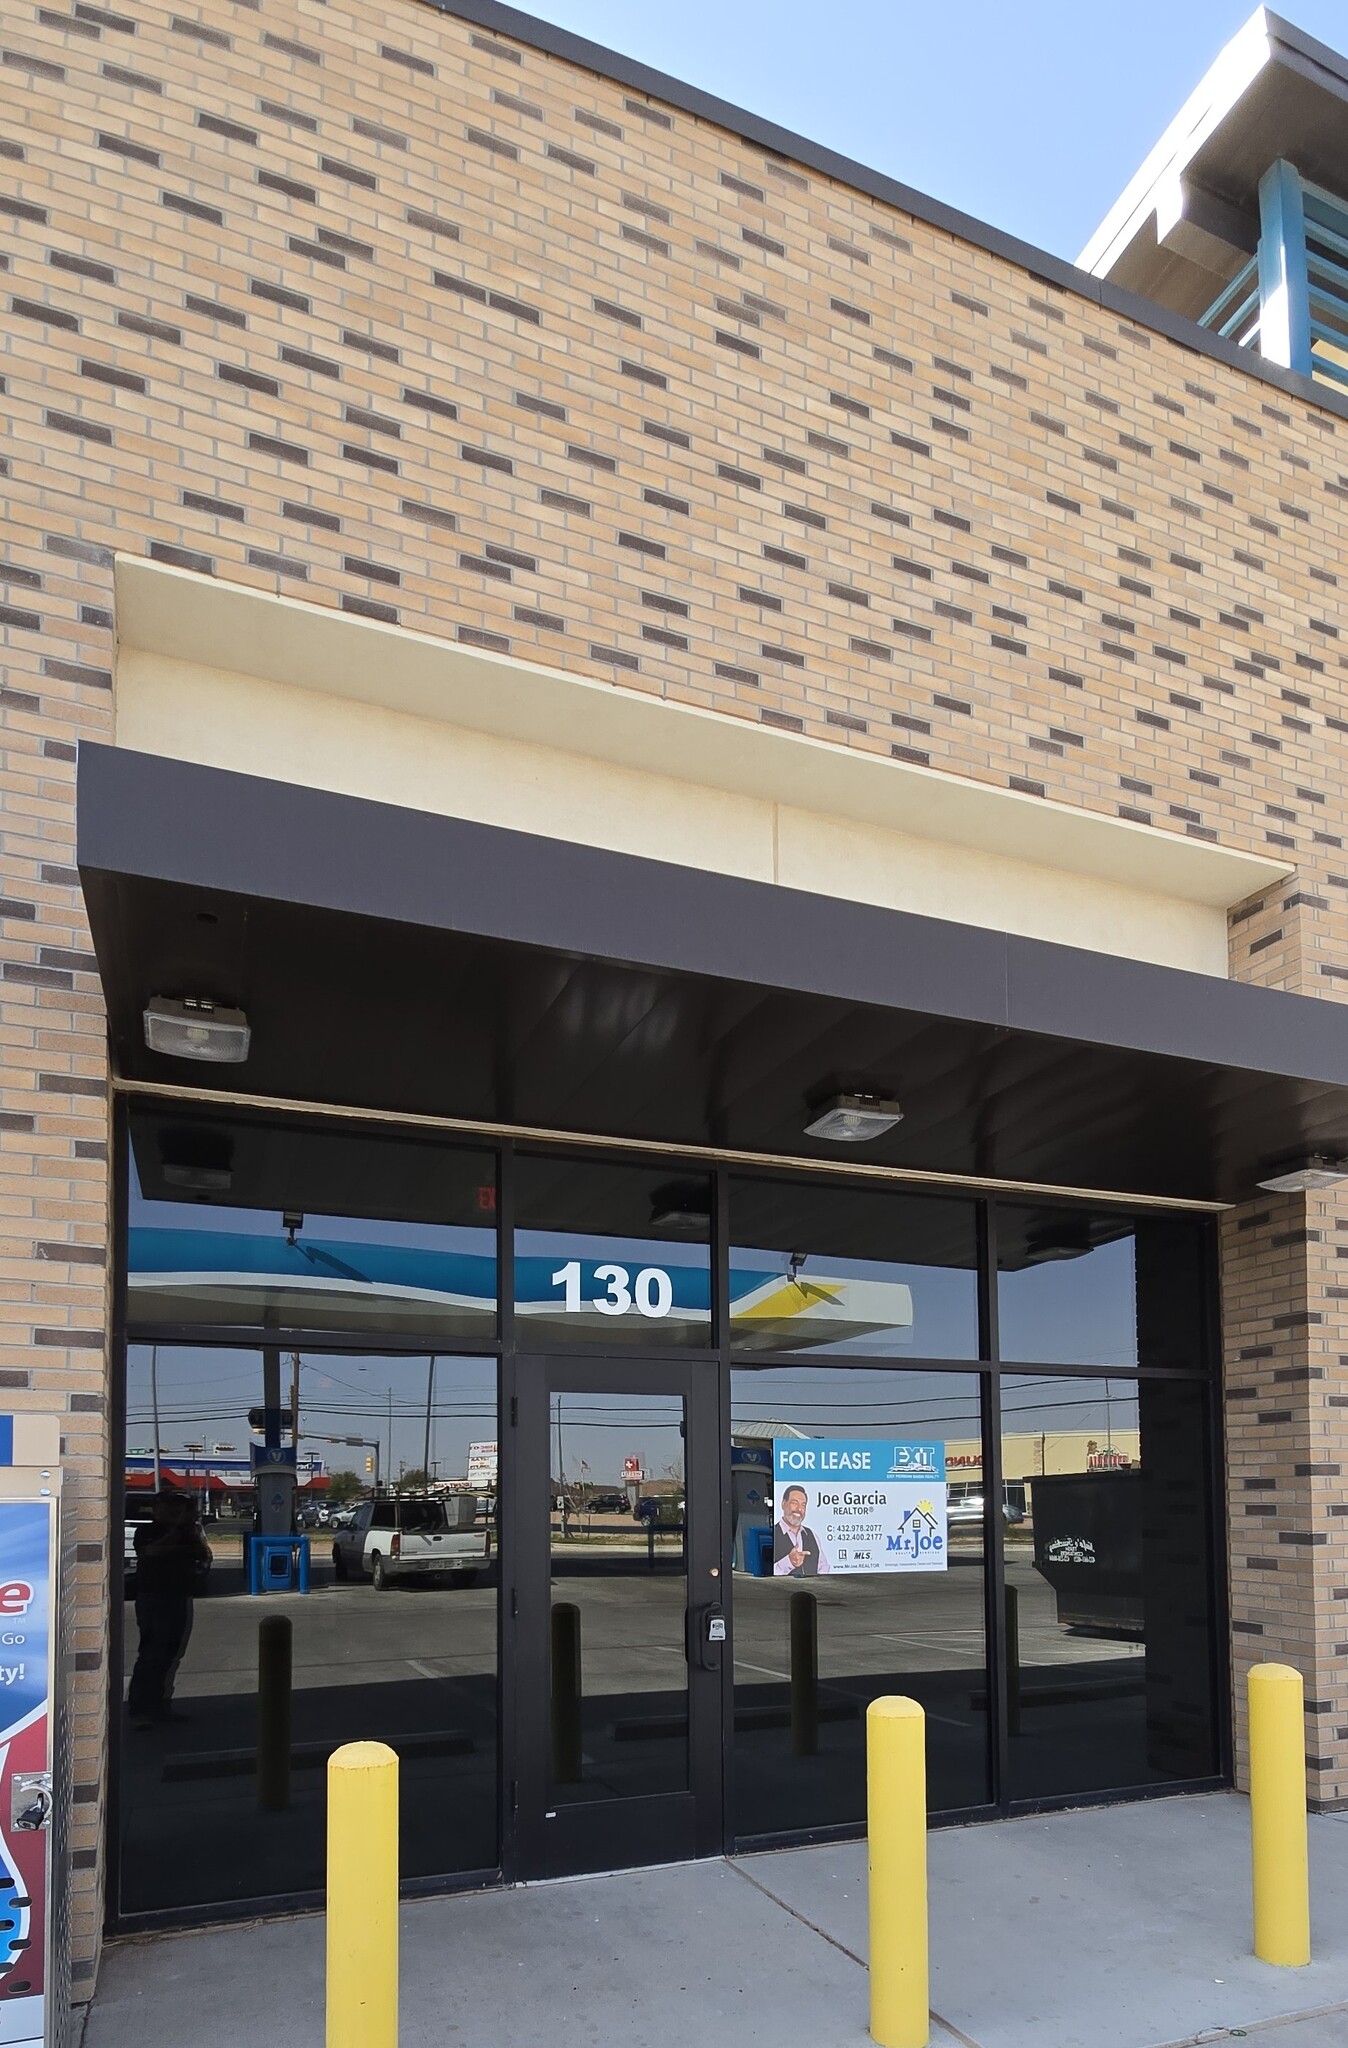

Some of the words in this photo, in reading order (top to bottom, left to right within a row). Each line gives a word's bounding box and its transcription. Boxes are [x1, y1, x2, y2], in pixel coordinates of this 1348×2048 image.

[552, 1262, 673, 1318] 130
[779, 1451, 816, 1470] FOR
[821, 1452, 871, 1470] LEASE
[816, 1491, 840, 1507] Joe
[843, 1490, 887, 1505] Garcia
[826, 1524, 836, 1532] C:
[837, 1524, 882, 1532] 432.978.2077
[826, 1533, 836, 1541] O:
[837, 1533, 883, 1541] 432.400.2177
[1, 1632, 25, 1645] Go
